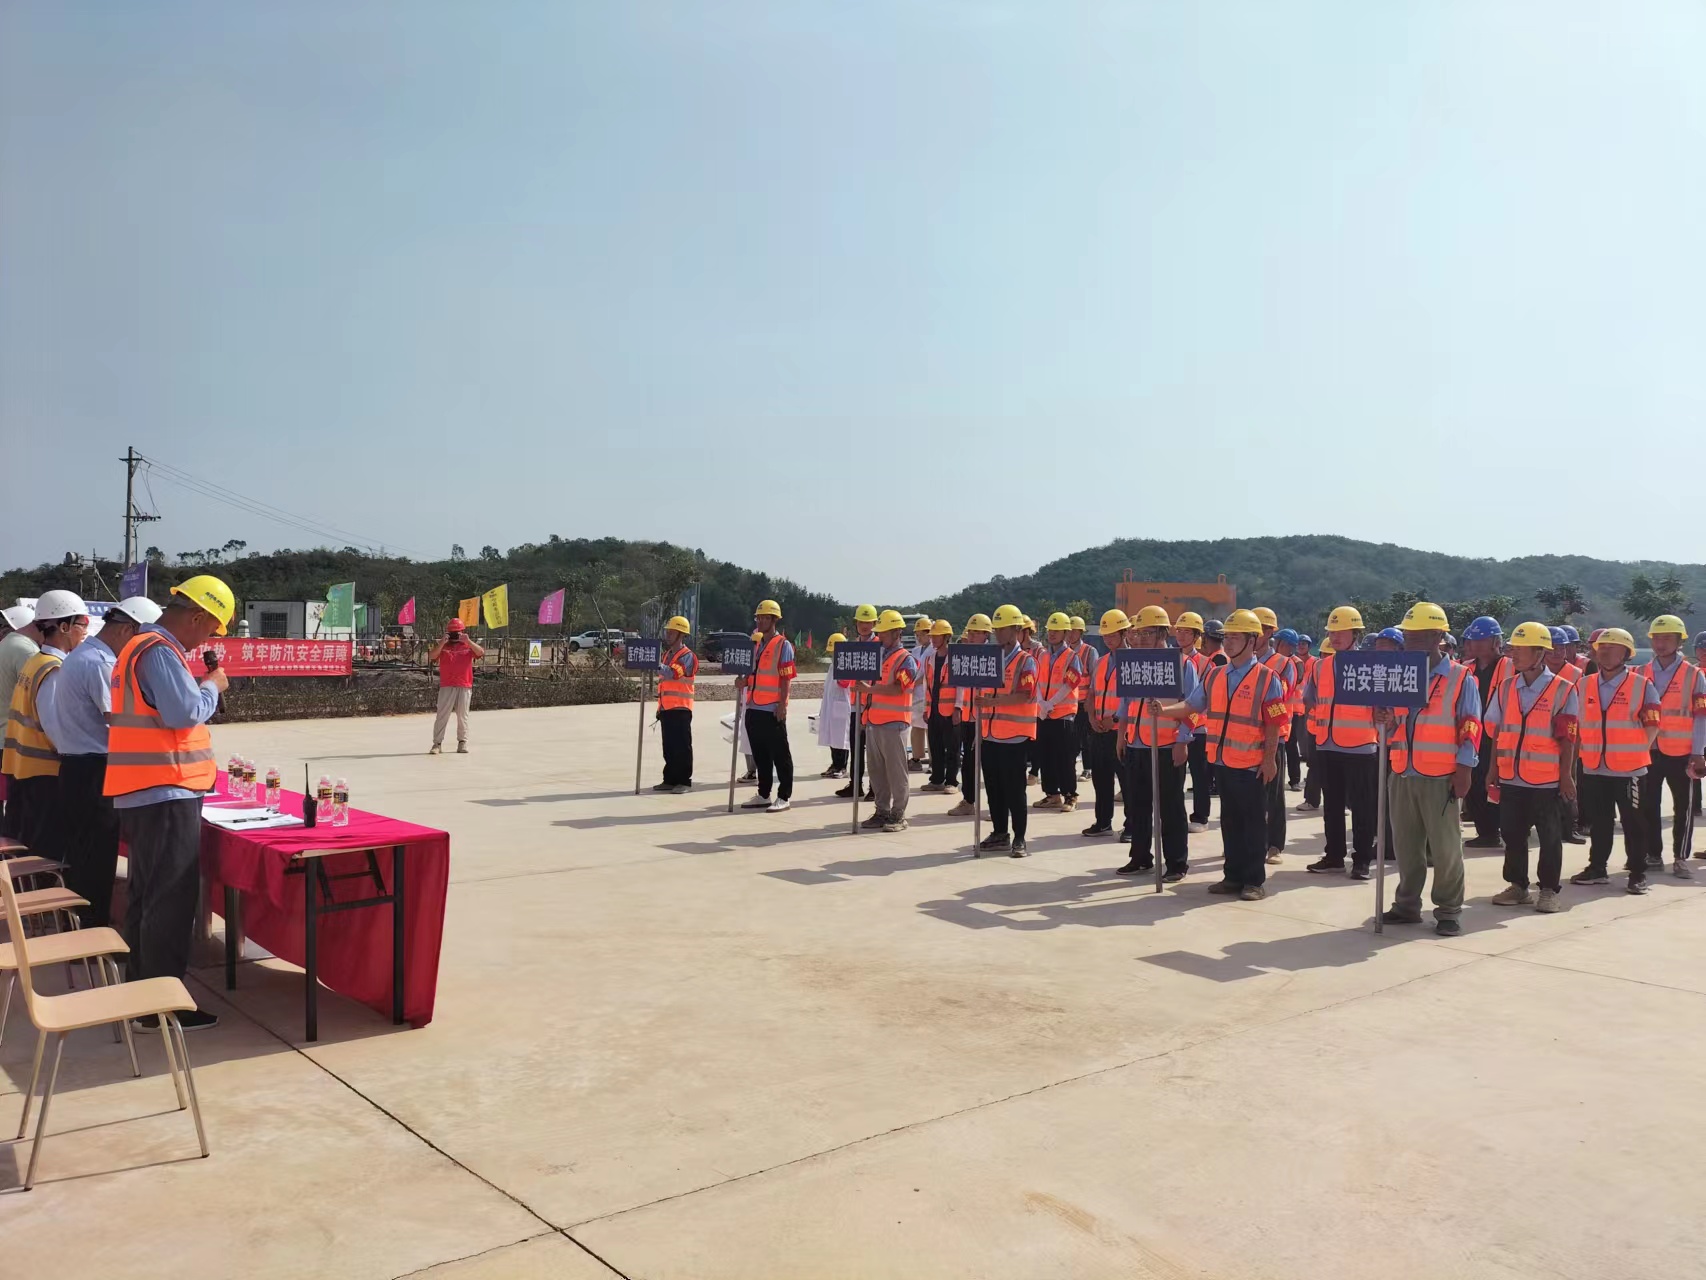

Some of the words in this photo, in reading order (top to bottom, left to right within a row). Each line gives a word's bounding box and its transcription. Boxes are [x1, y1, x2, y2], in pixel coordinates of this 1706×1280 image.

[628, 646, 656, 662] 医疗救治组
[724, 648, 752, 667] 技术保障组
[837, 651, 876, 671] 通讯联络组
[952, 654, 998, 678] 物资供应组
[1121, 661, 1176, 686] 抢险救援组
[1342, 664, 1418, 693] 治安警戒组
